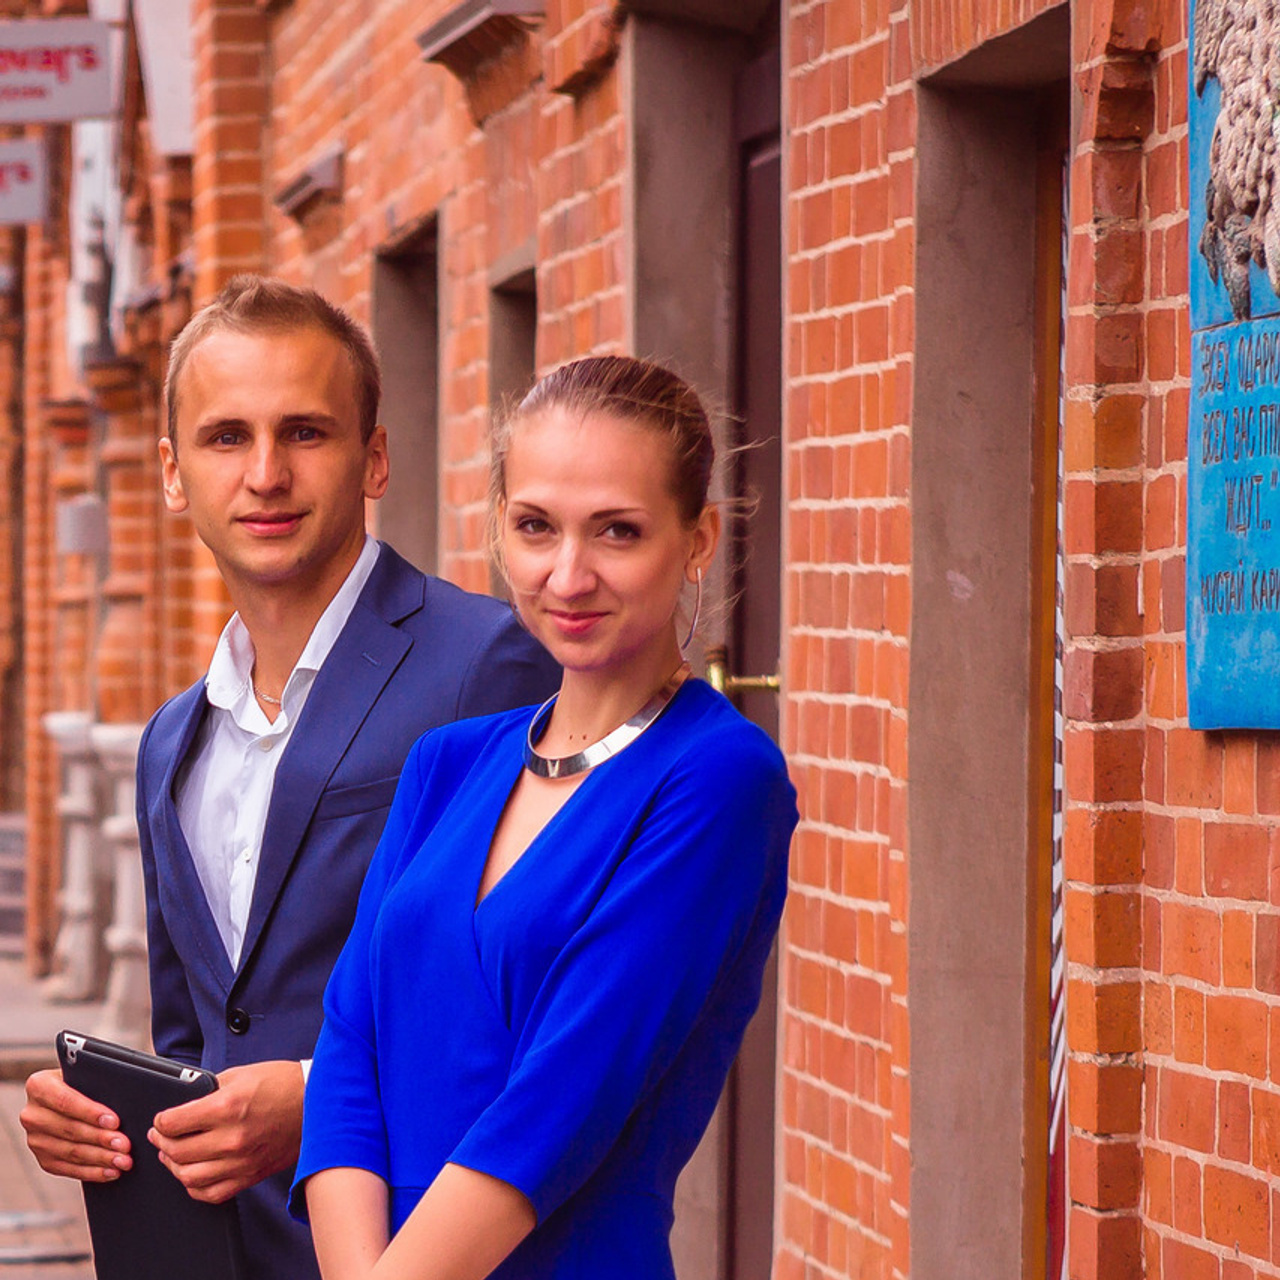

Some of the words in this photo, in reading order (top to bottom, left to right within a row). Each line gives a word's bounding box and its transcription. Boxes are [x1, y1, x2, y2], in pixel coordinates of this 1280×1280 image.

[1202, 409, 1229, 467] ВСЕХ
[1233, 405, 1256, 462] ВАС
[1200, 558, 1245, 615] МУСТАЙ
